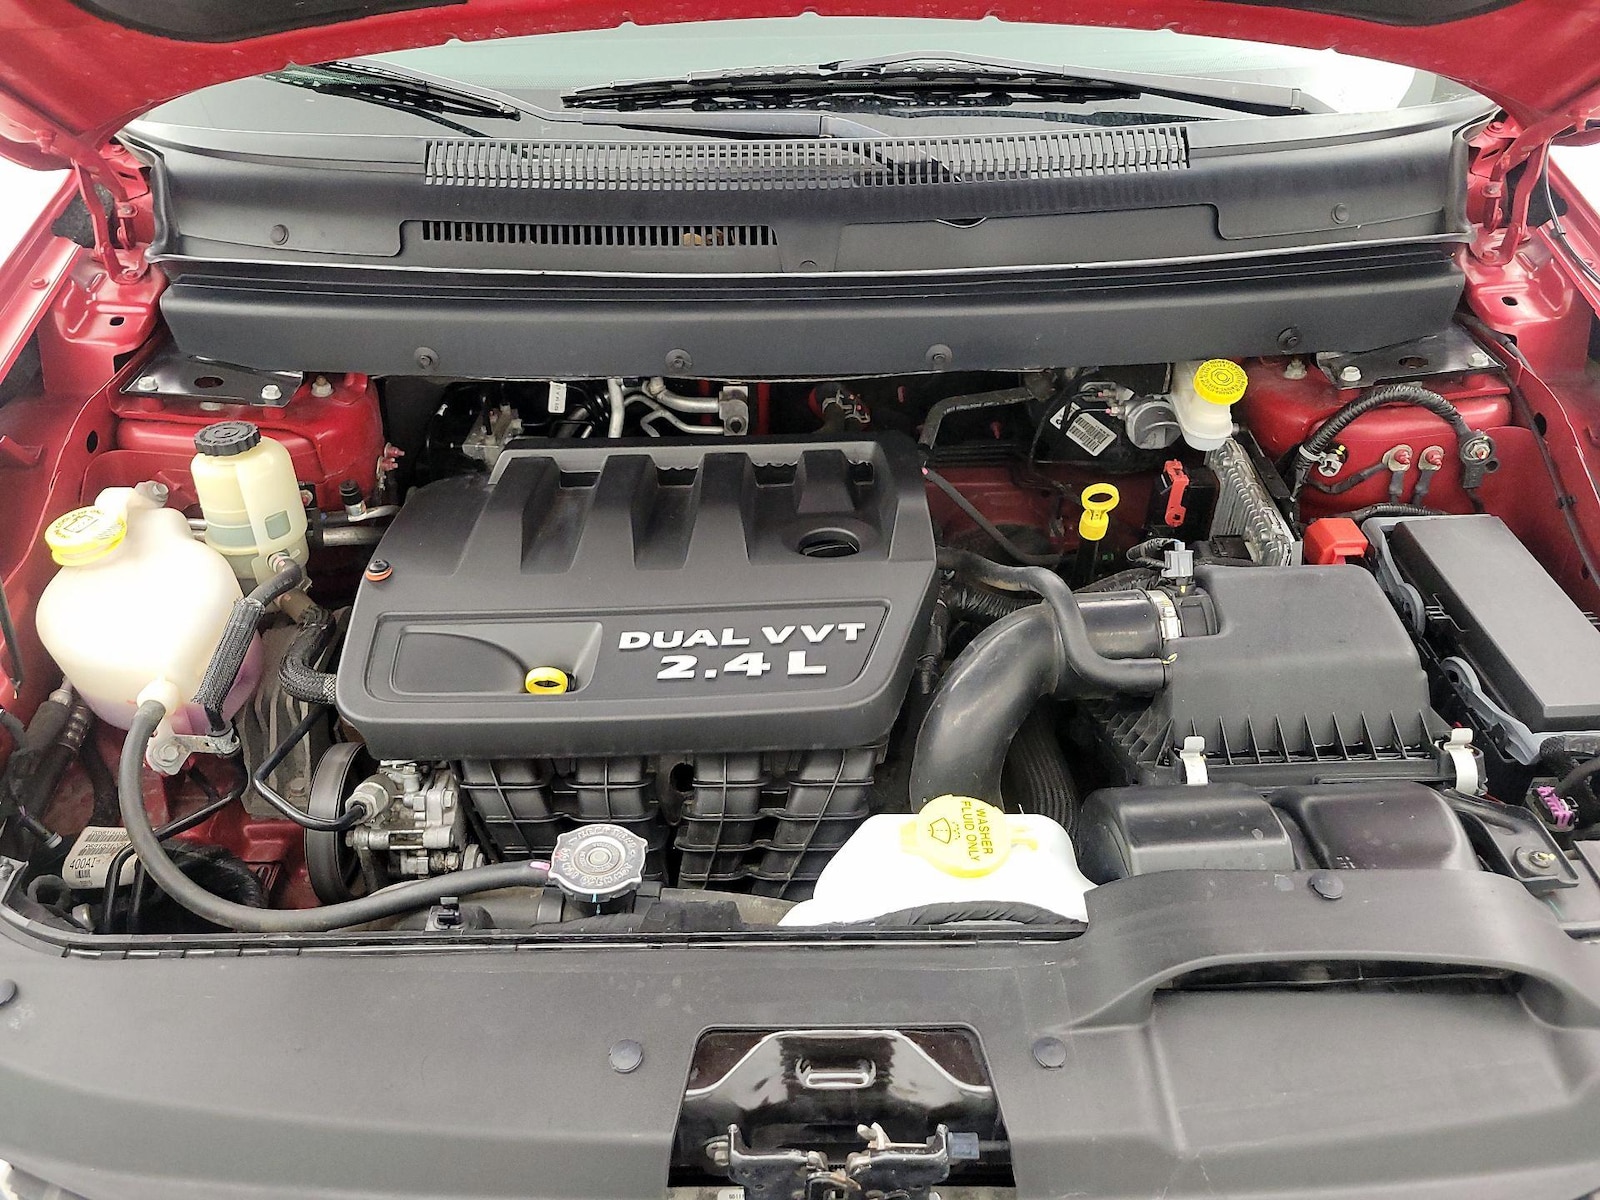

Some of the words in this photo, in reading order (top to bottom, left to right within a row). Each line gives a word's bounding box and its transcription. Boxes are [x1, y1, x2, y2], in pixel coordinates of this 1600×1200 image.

[618, 628, 750, 650] DUAL
[761, 622, 866, 645] VVT
[961, 801, 975, 831] FLUID
[976, 808, 994, 855] WASHER
[966, 834, 981, 862] ONLY
